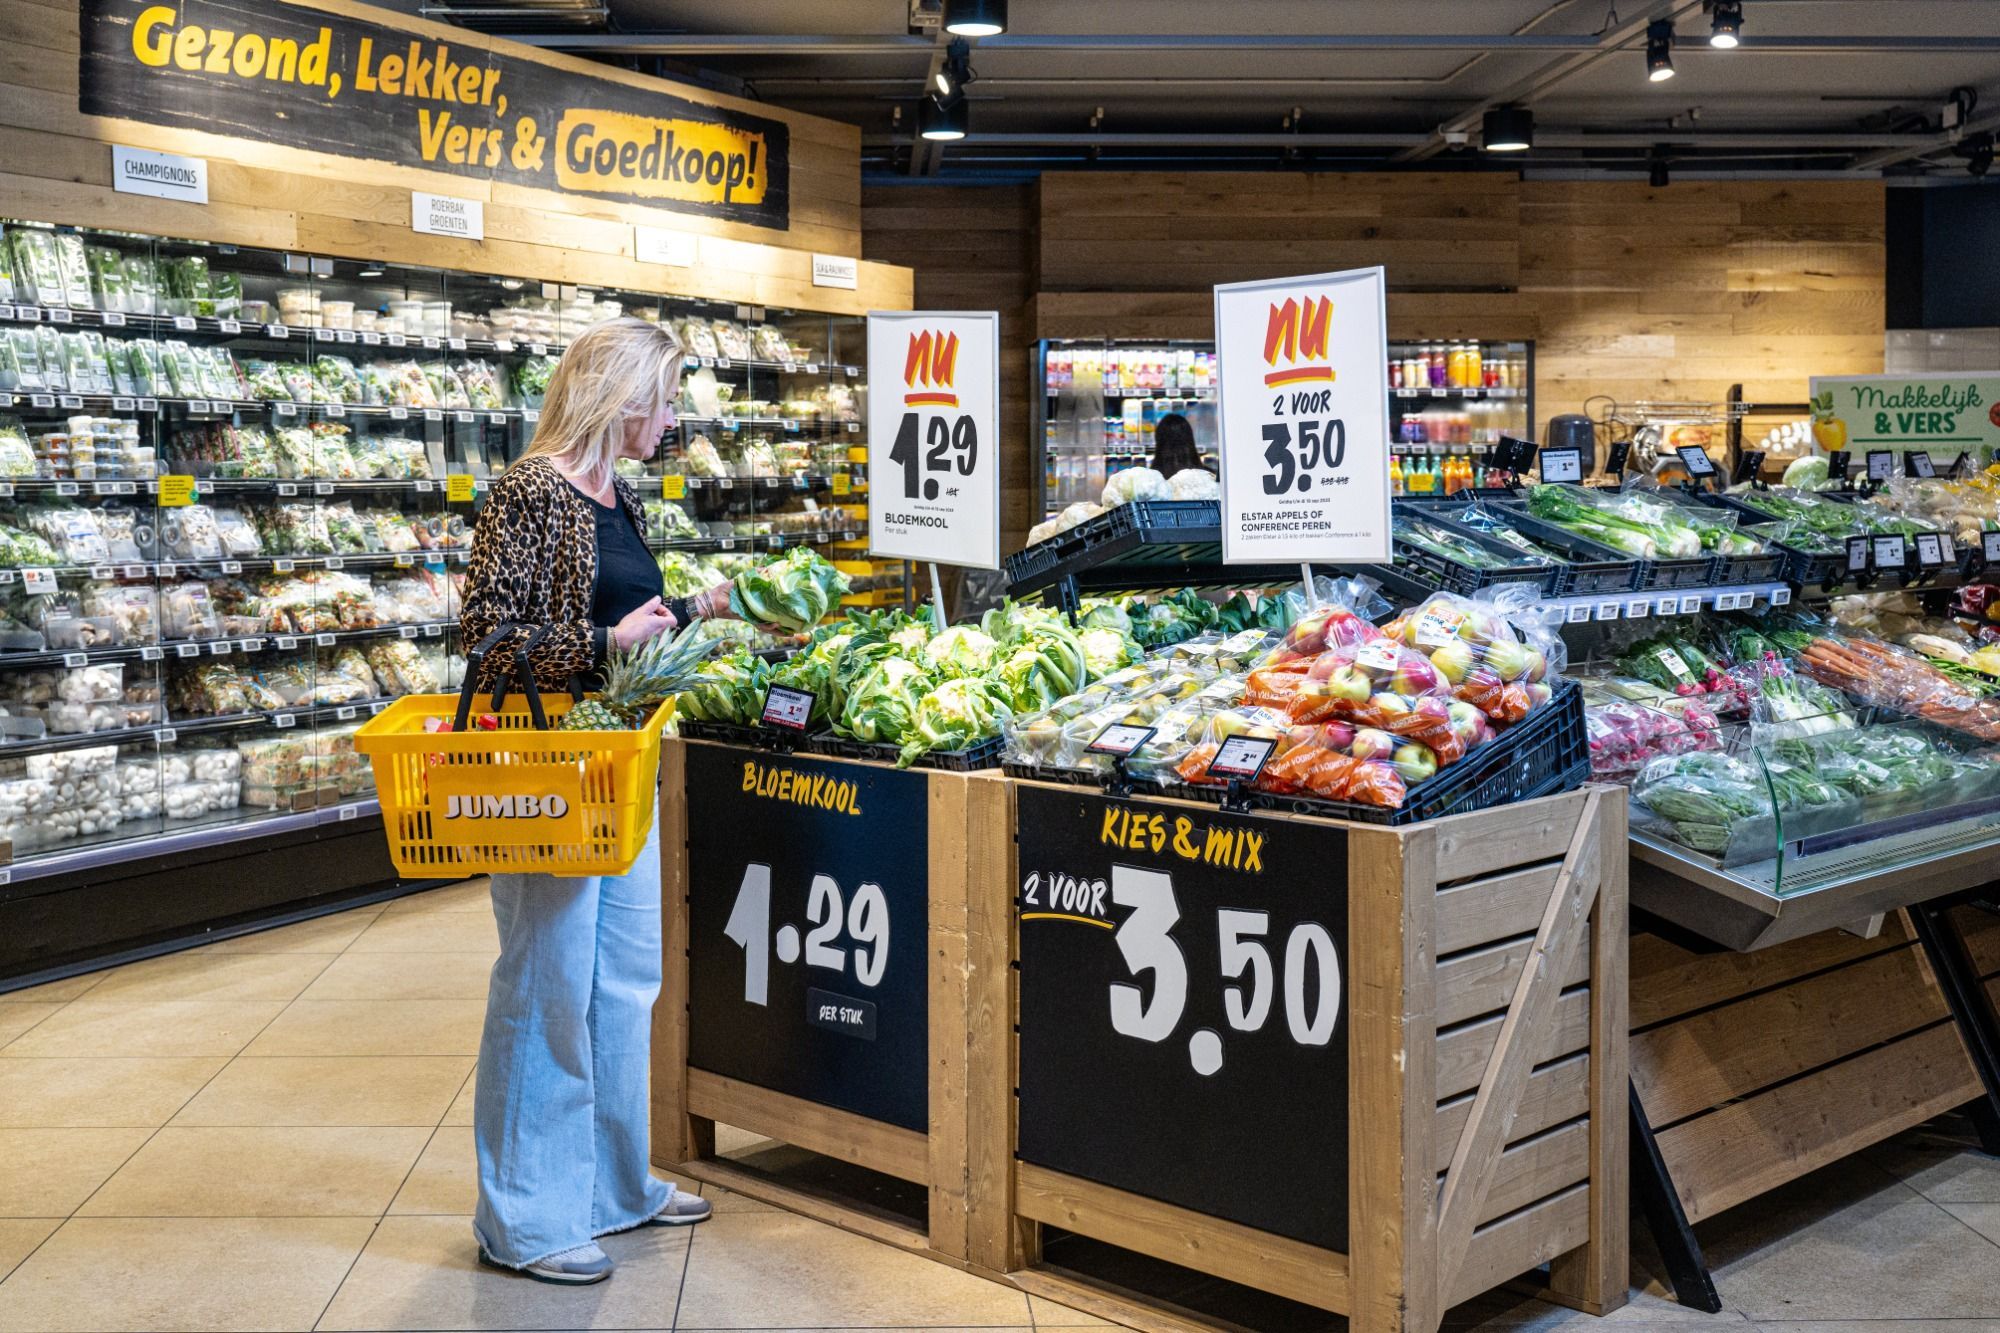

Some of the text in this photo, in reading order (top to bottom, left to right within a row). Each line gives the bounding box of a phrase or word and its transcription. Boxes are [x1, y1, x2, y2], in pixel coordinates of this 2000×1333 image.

[132, 6, 508, 118] Gezond, Lekker,
[417, 108, 758, 204] Vers & Goedkoop!
[125, 160, 197, 184] CHAMPIGNONS
[431, 199, 465, 214] ROERBAK
[430, 214, 468, 230] GROENTEN
[1273, 389, 1332, 416] 2 VOOR
[1850, 384, 1983, 414] Makkelijk
[1874, 411, 1956, 434] & VERS
[889, 412, 978, 500] 1.29
[1261, 418, 1346, 496] 3.50
[885, 513, 949, 529] BLOEMKOOL
[1241, 510, 1323, 521] ELSTAR APPELS OF
[1241, 521, 1332, 532] CONFERENCE PEREN
[742, 761, 861, 817] BLOEMKOOL
[445, 794, 569, 819] JUMBO
[1101, 807, 1263, 872] KIES & MIX
[1023, 873, 1107, 917] 2 VOOR
[723, 862, 890, 1006] 1.29
[1108, 862, 1341, 1076] 3.50
[819, 1004, 863, 1025] PER STUK
